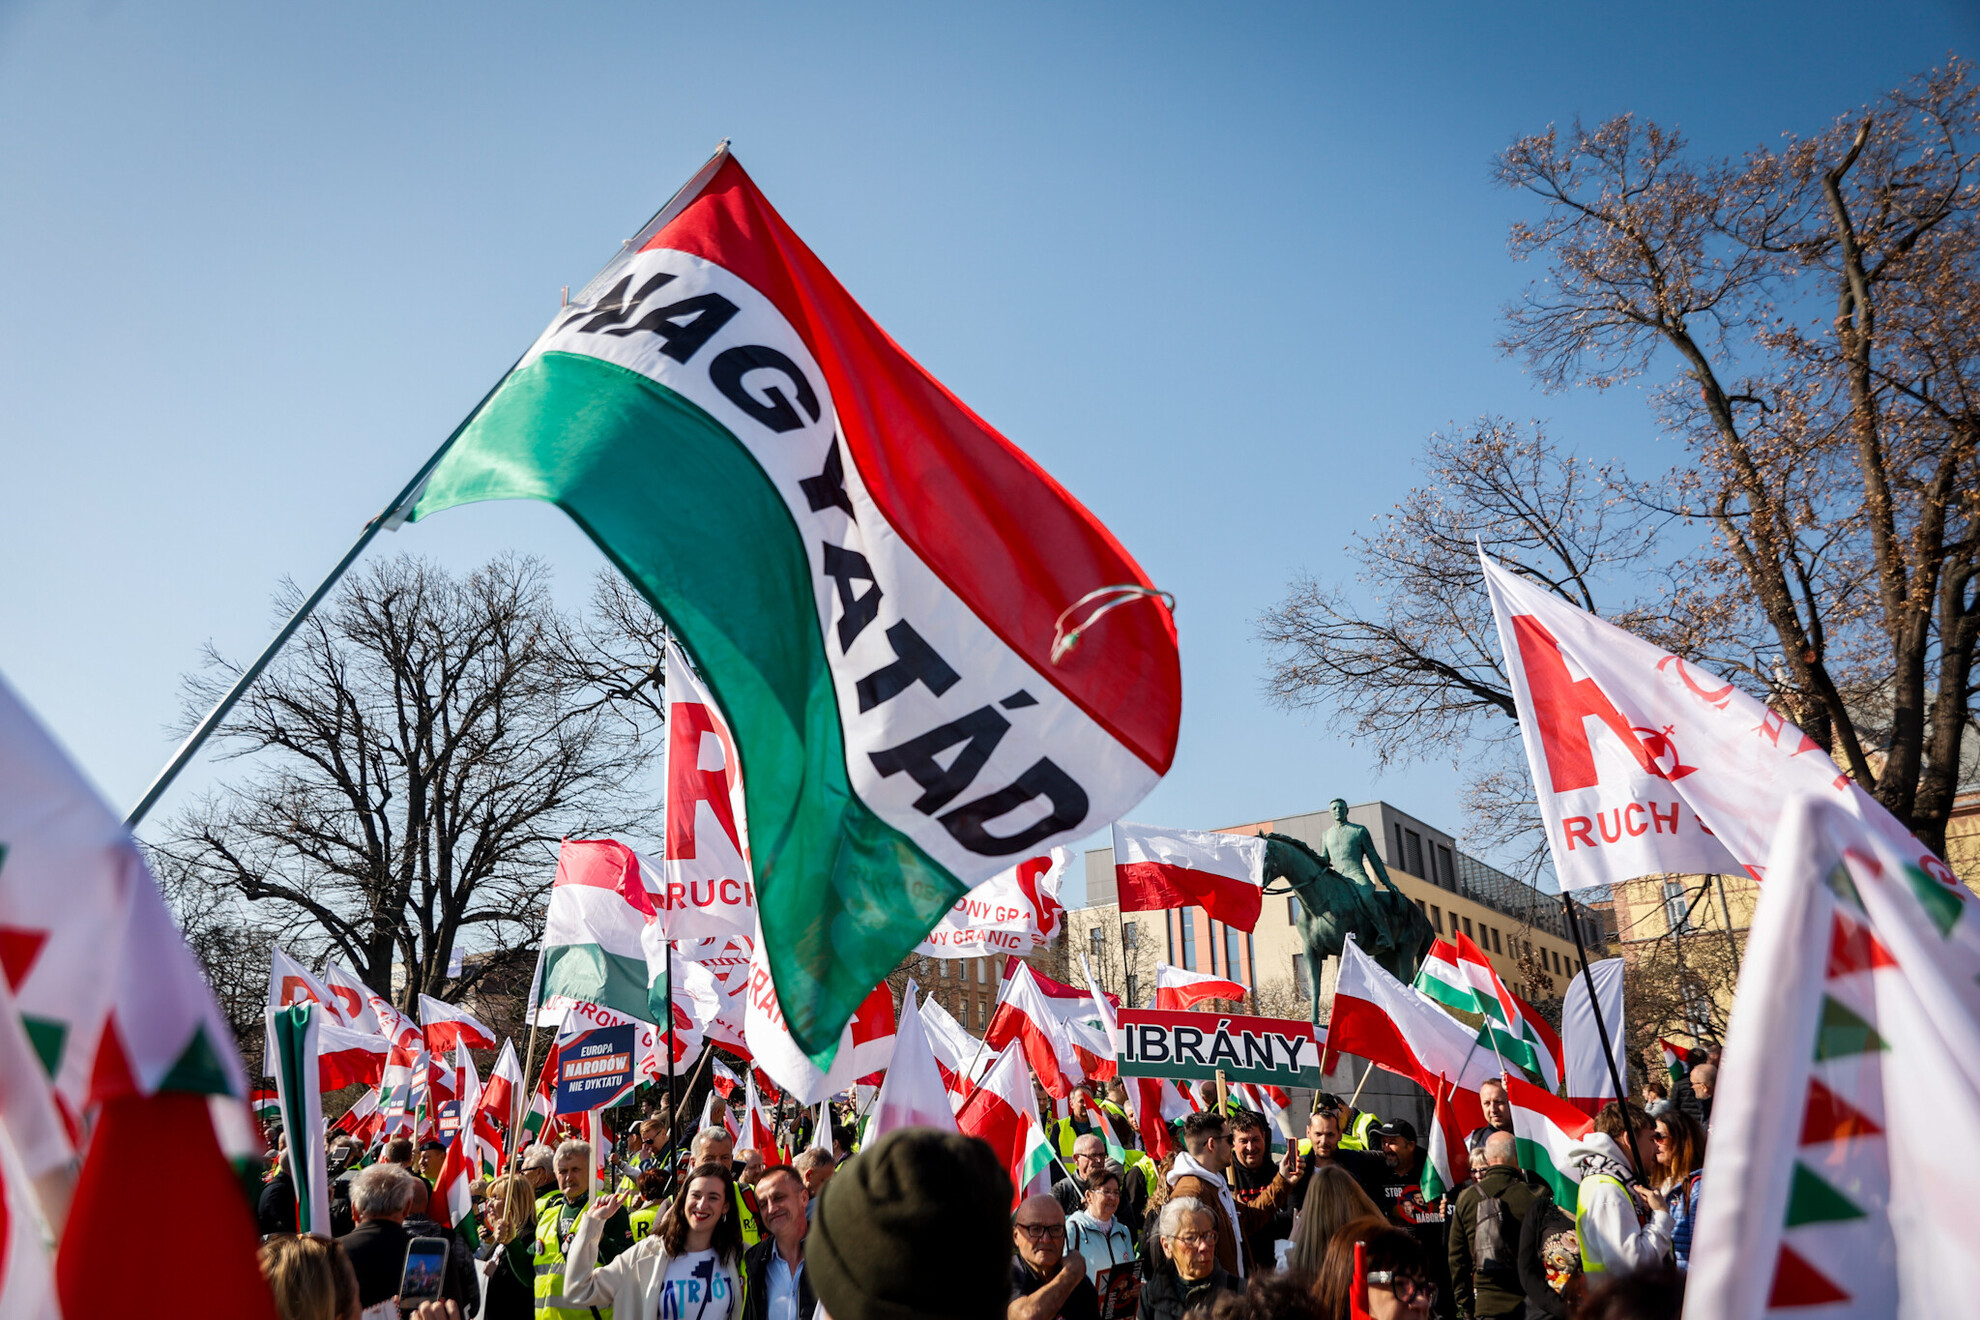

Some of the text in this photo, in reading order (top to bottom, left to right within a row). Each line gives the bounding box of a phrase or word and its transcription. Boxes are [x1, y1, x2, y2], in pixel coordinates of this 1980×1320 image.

[553, 272, 1090, 857] NAGYATÁD
[1562, 801, 1679, 850] RUCH
[953, 929, 1022, 949] GRANIC
[581, 1043, 613, 1057] EUROPA
[1124, 1019, 1307, 1073] IBRÁNY
[565, 1055, 627, 1077] NARODÓW
[569, 1075, 623, 1092] NIE DYKTATU
[1385, 1187, 1403, 1197] STOP
